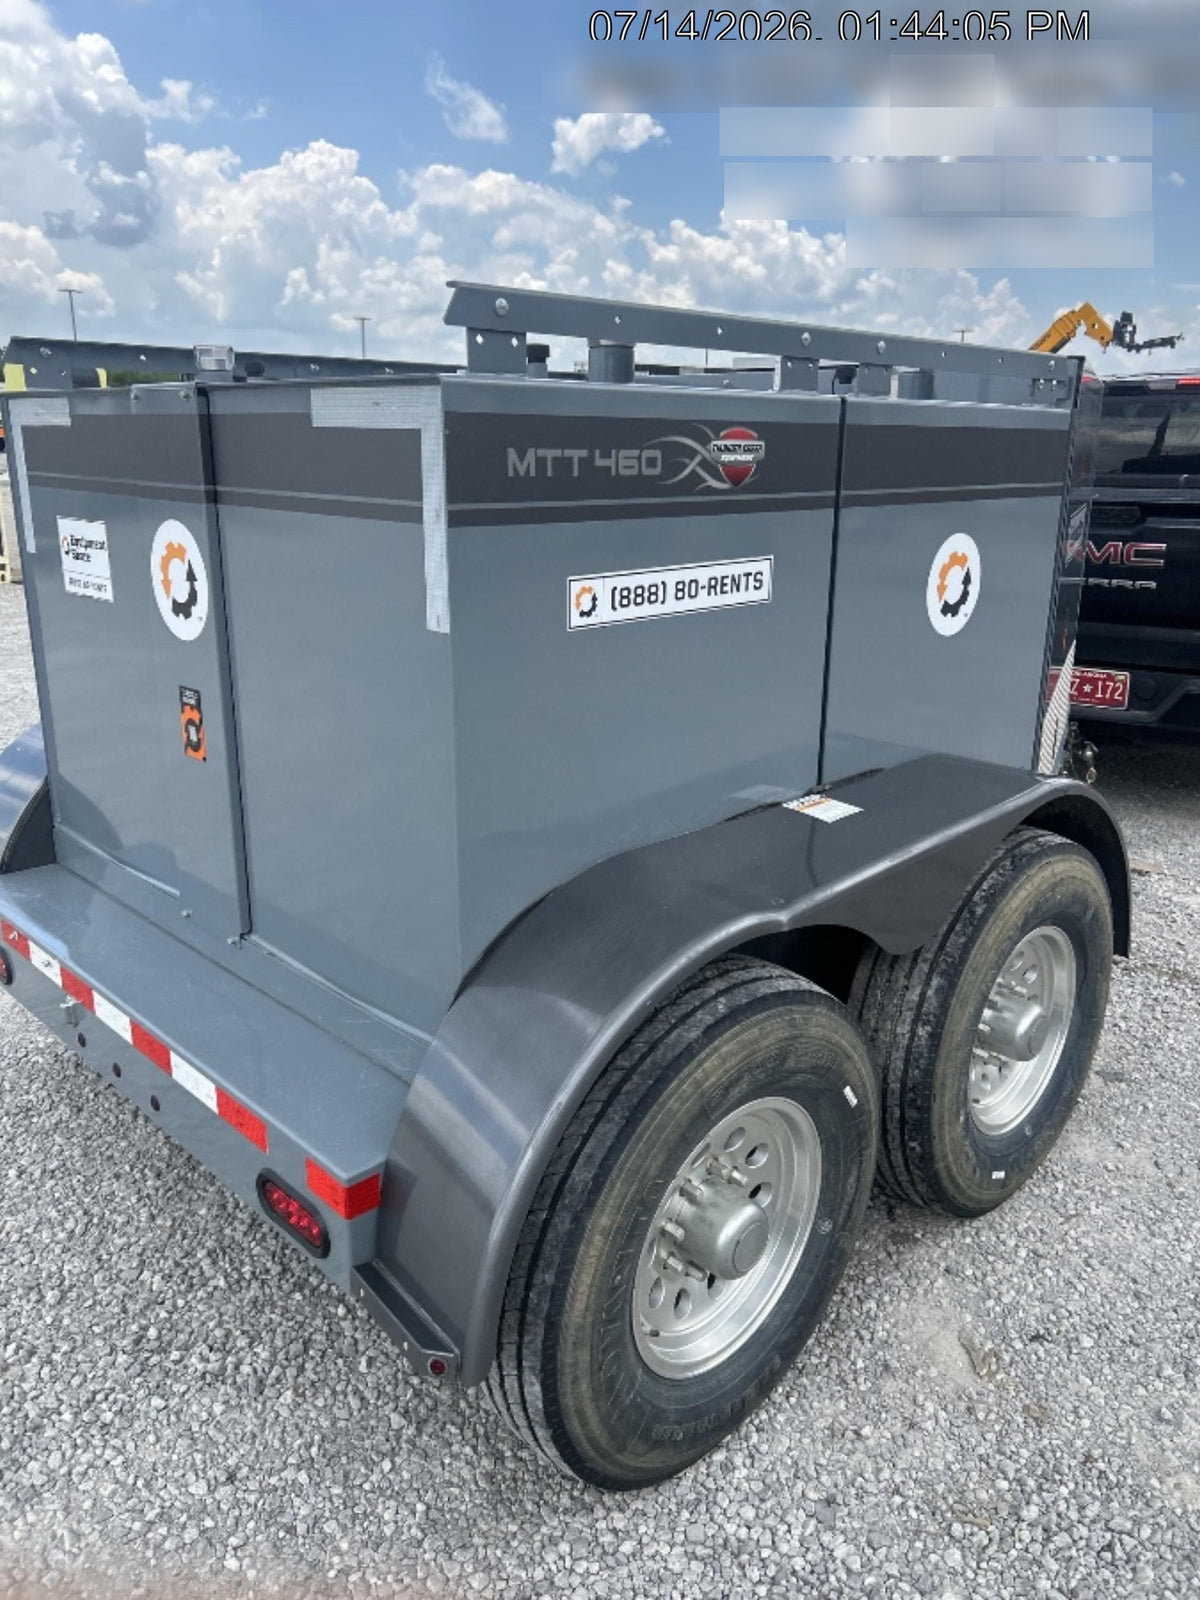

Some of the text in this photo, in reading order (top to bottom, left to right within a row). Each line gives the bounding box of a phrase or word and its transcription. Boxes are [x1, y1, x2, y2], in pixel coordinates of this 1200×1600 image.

[507, 447, 662, 477] MTT 460
[610, 571, 764, 611] (888) 80-RENTS
